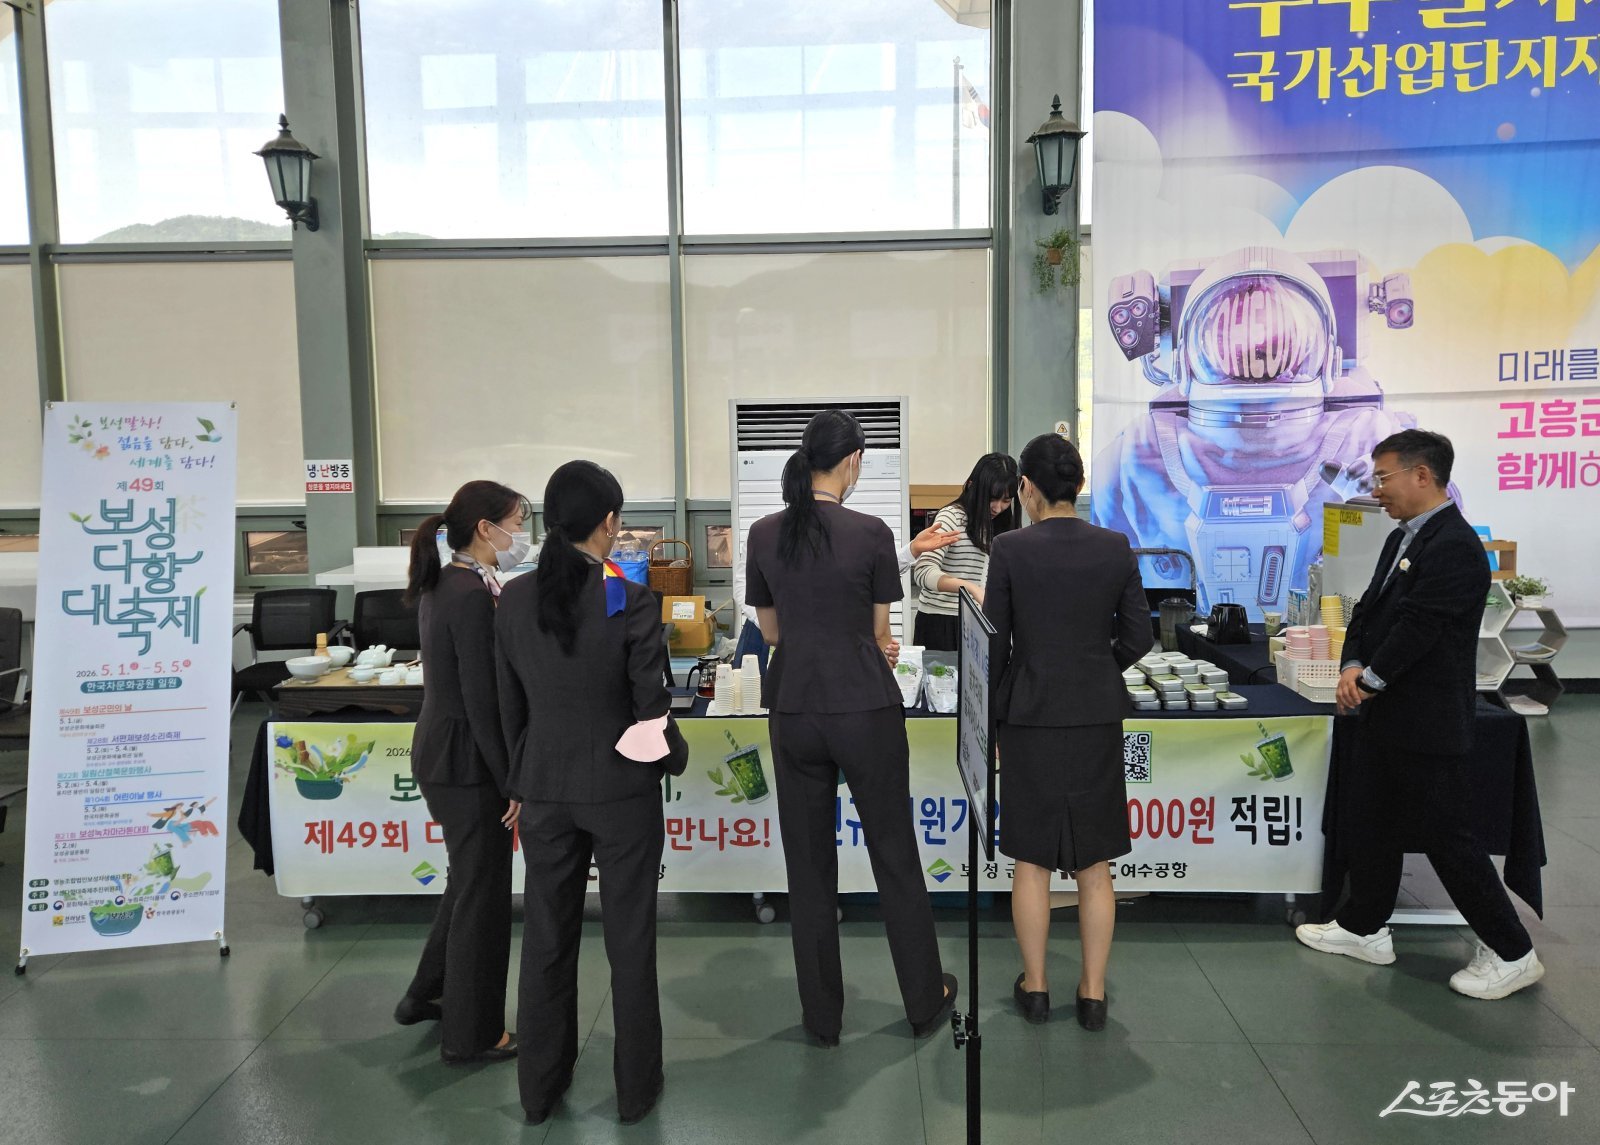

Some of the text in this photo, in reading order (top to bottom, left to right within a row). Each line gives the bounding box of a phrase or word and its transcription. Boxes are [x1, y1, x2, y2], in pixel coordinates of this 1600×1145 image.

[1499, 348, 1599, 382] 미래를
[180, 456, 216, 469] 담다!
[116, 478, 164, 492] 제49회
[82, 498, 176, 550] 보성
[94, 539, 204, 594] 다향
[62, 584, 200, 656] 대축제
[86, 678, 178, 692] 한국차문화공원 일원
[114, 792, 144, 801] 어린이날
[304, 819, 408, 854] 제49회
[666, 816, 770, 851] 만나요!
[1230, 794, 1302, 846] 적립!
[1121, 862, 1188, 879] 여수공항
